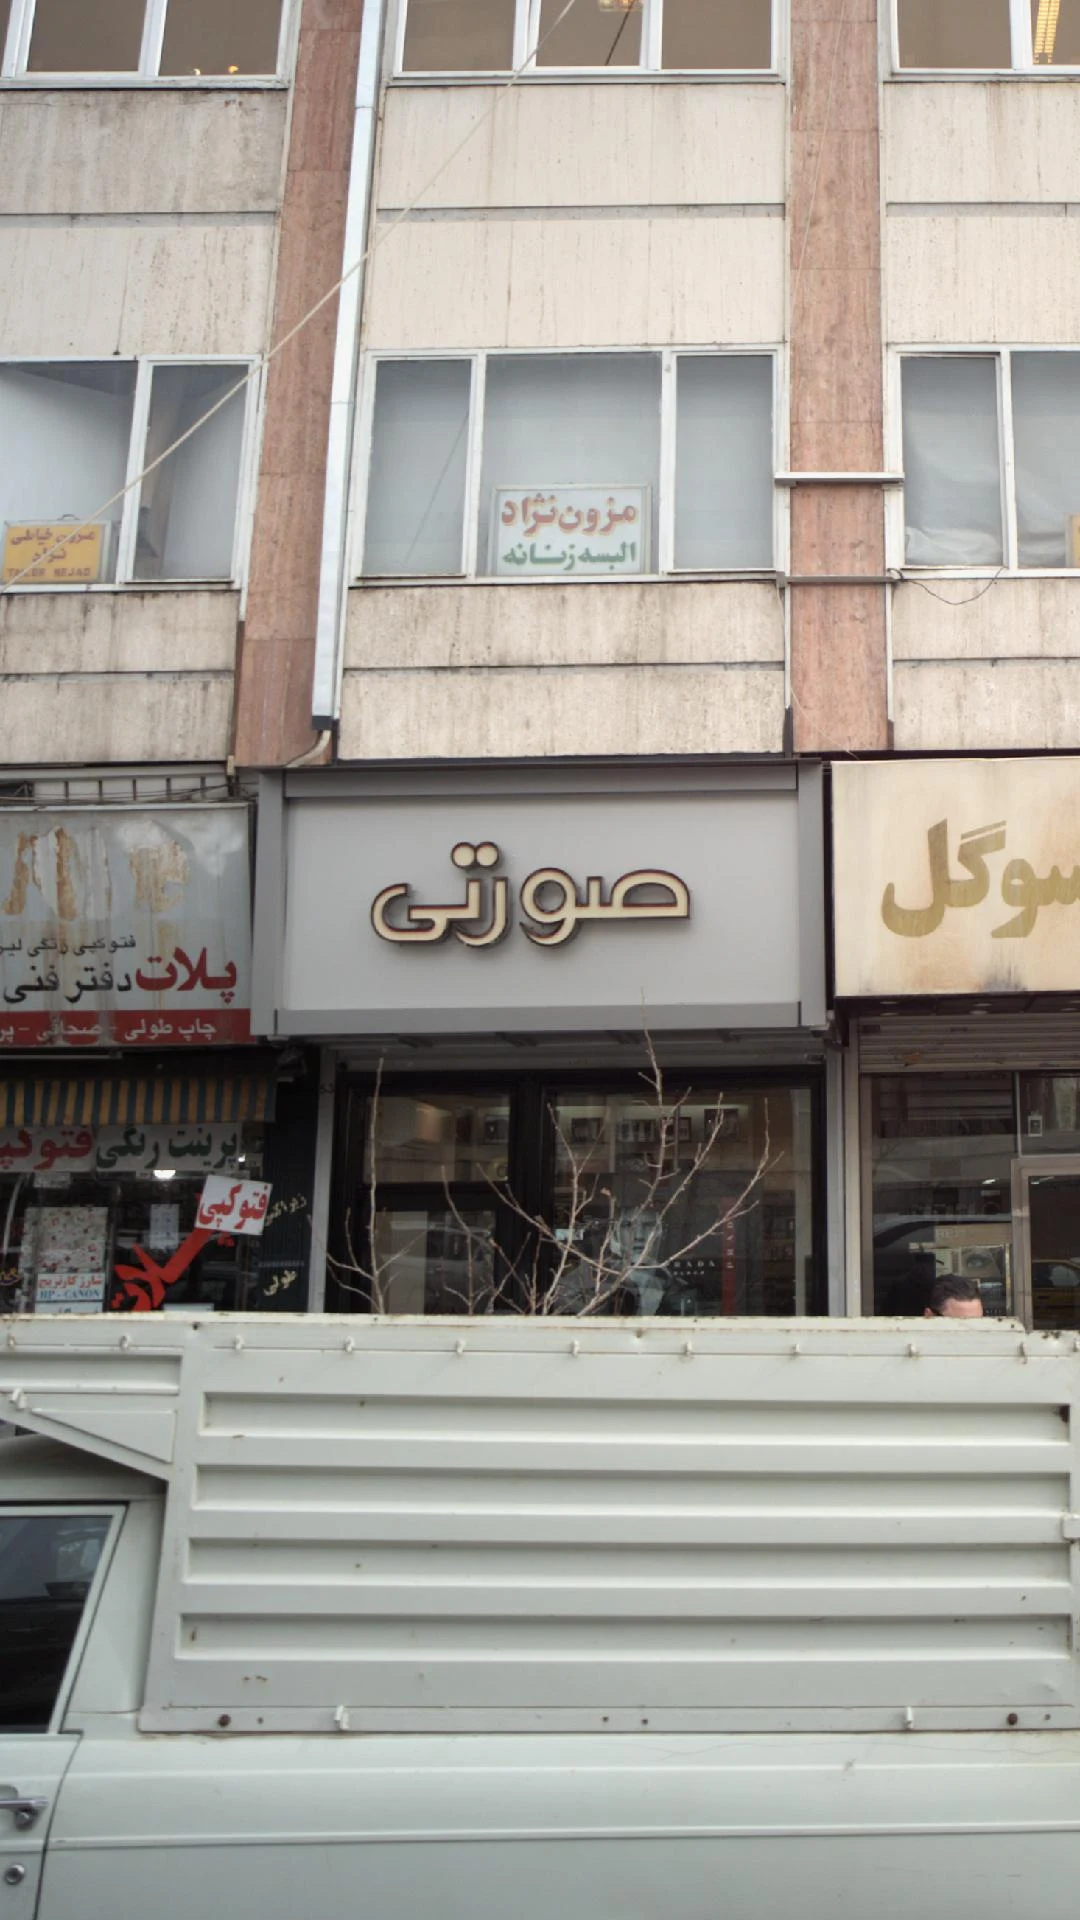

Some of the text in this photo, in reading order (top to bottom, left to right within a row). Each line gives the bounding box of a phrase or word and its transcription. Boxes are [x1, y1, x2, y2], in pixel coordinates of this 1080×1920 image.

[501, 492, 638, 537] مزون نژاد
[502, 541, 637, 571] البسه زنانه
[370, 841, 691, 947] صورتی
[4, 962, 132, 1003] دفتر فنی
[136, 947, 237, 1004] پلات
[124, 1018, 172, 1041] طولی
[178, 1017, 217, 1042] چاپ
[168, 1126, 238, 1169] پرینت
[199, 1182, 269, 1230] فتوکپی
[672, 1259, 717, 1268] RADA
[40, 1289, 56, 1300] HP
[64, 1288, 100, 1300] CANON
